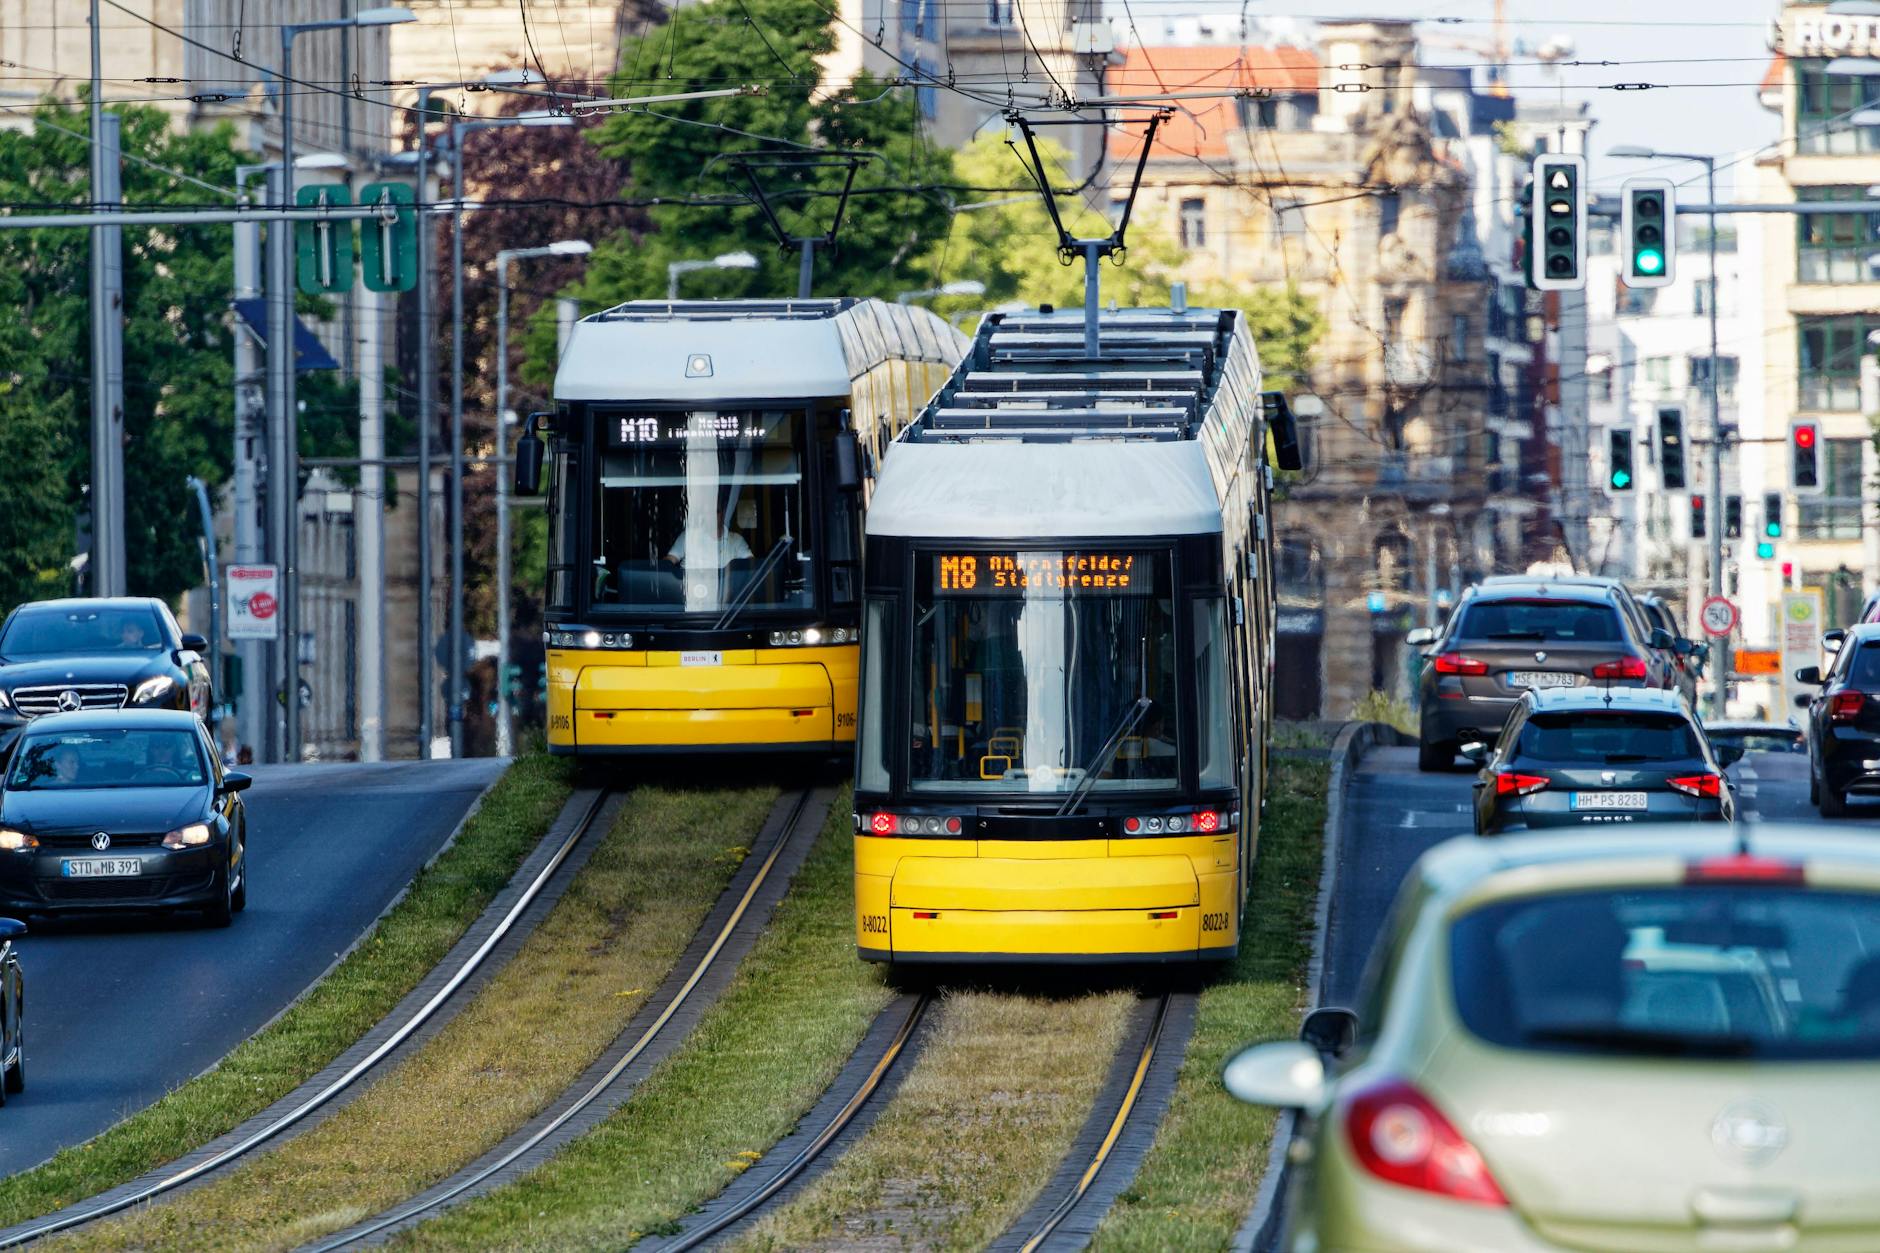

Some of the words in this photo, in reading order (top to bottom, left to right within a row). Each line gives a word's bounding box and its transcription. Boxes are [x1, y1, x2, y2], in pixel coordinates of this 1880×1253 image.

[621, 418, 658, 442] M10
[990, 555, 1133, 571] Ahrensfelde/
[941, 556, 977, 589] M8
[994, 572, 1130, 590] Stadtgrenze
[1708, 606, 1729, 625] 50
[1578, 795, 1593, 806] HH
[1601, 794, 1615, 806] PS
[70, 861, 92, 875] STD
[101, 861, 115, 874] MB
[118, 860, 139, 873] 391
